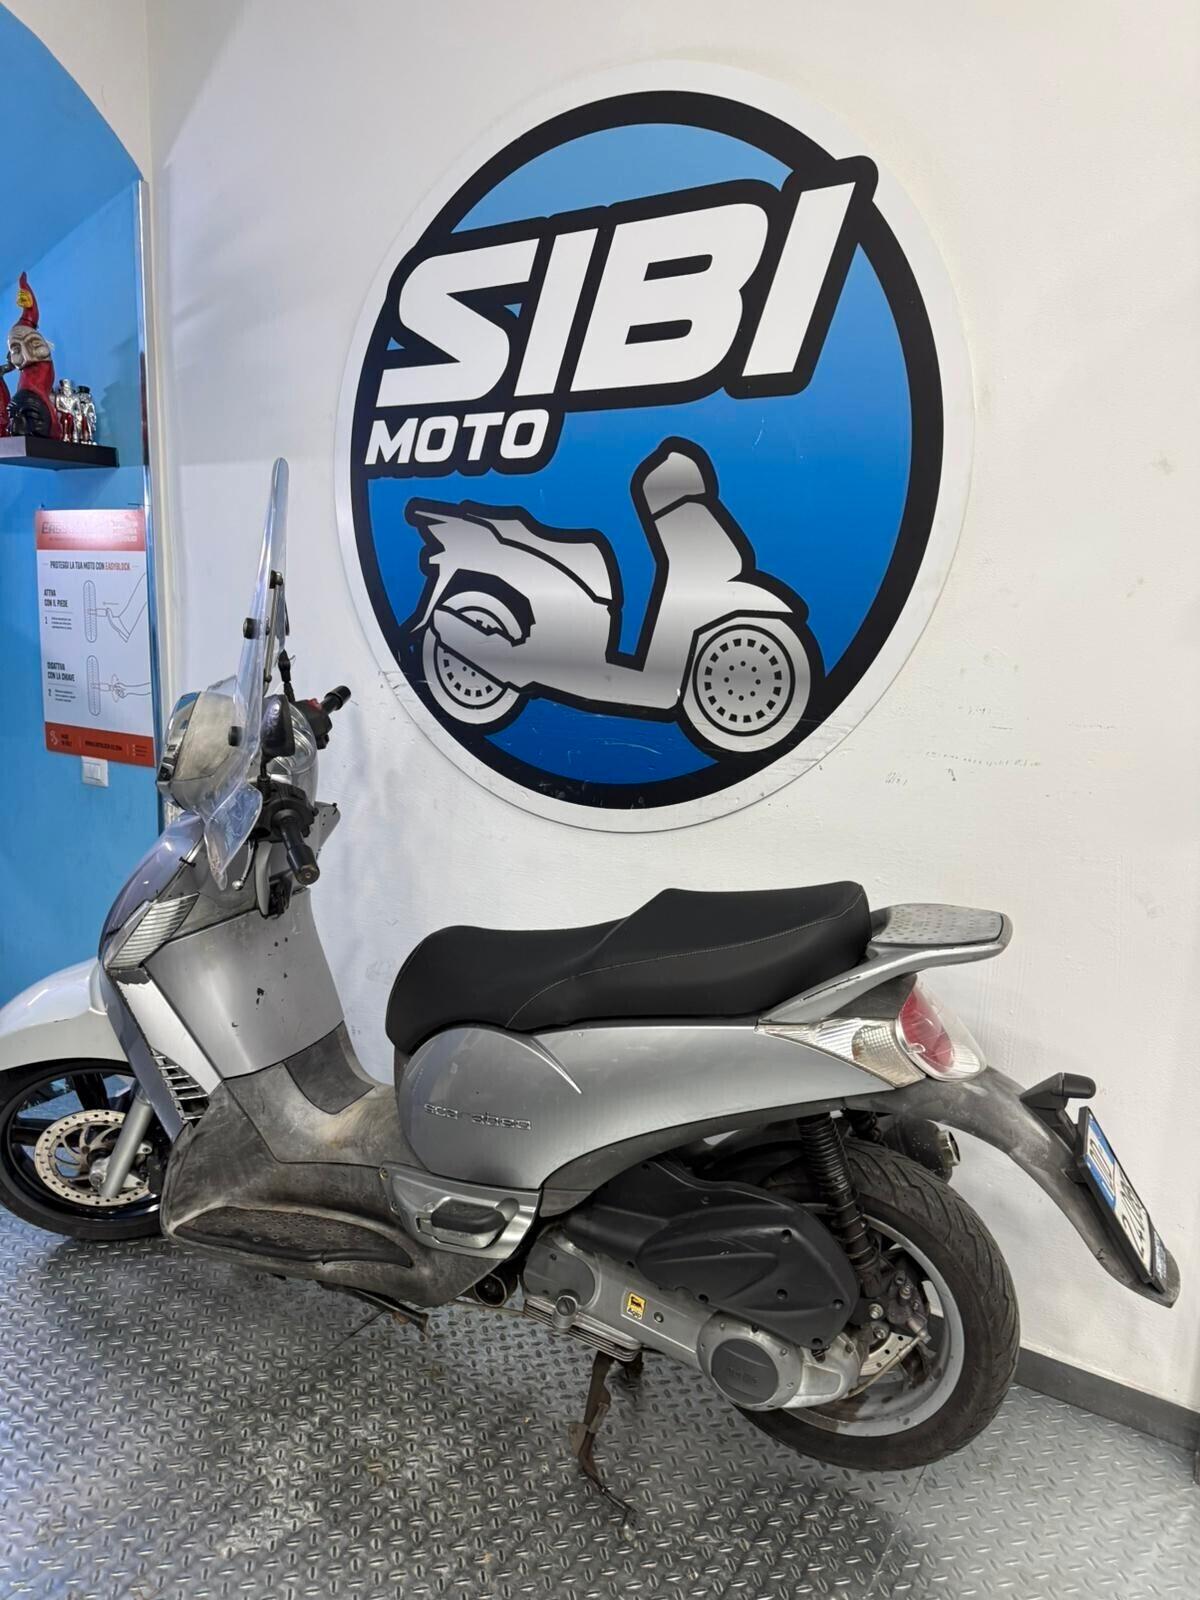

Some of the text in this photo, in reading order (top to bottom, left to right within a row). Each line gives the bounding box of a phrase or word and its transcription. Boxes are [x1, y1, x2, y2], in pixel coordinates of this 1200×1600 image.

[375, 181, 857, 408] SIBI
[364, 408, 551, 466] MOTO
[75, 561, 84, 570] TUA
[84, 561, 95, 570] MOTO
[96, 562, 104, 570] CON
[57, 599, 68, 608] PIEDE
[56, 672, 61, 680] LA
[62, 673, 75, 682] CHIAVE
